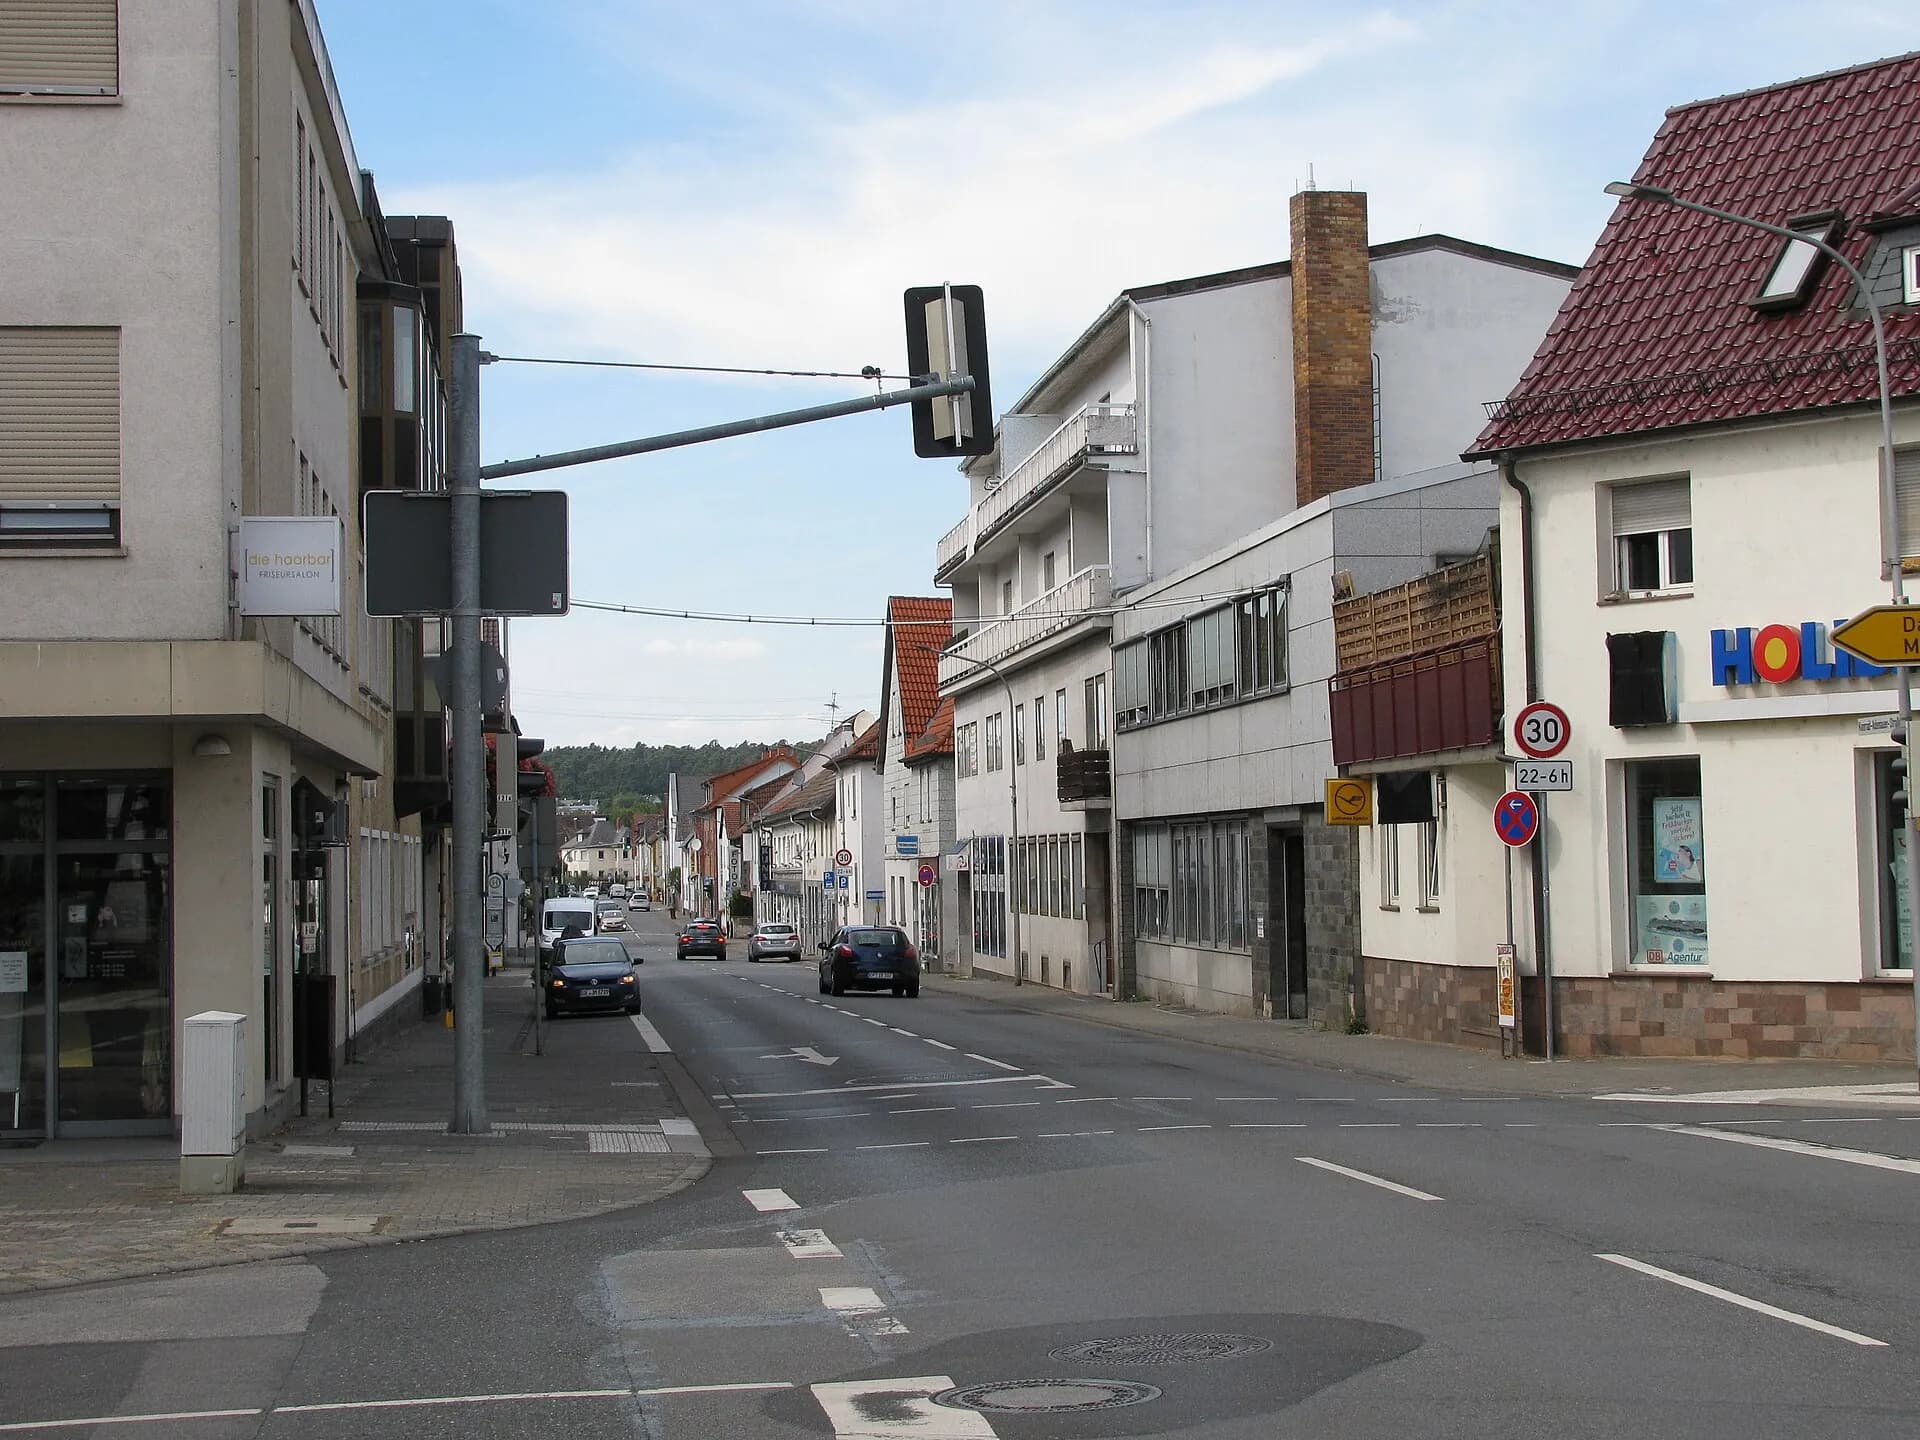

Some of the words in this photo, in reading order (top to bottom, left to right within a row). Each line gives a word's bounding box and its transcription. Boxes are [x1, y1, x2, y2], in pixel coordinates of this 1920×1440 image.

[248, 553, 269, 566] die
[274, 553, 331, 566] haarbar
[259, 570, 320, 579] FRISEURSALON
[1527, 718, 1559, 744] 30
[839, 853, 849, 862] 30
[1668, 952, 1703, 964] Agentur
